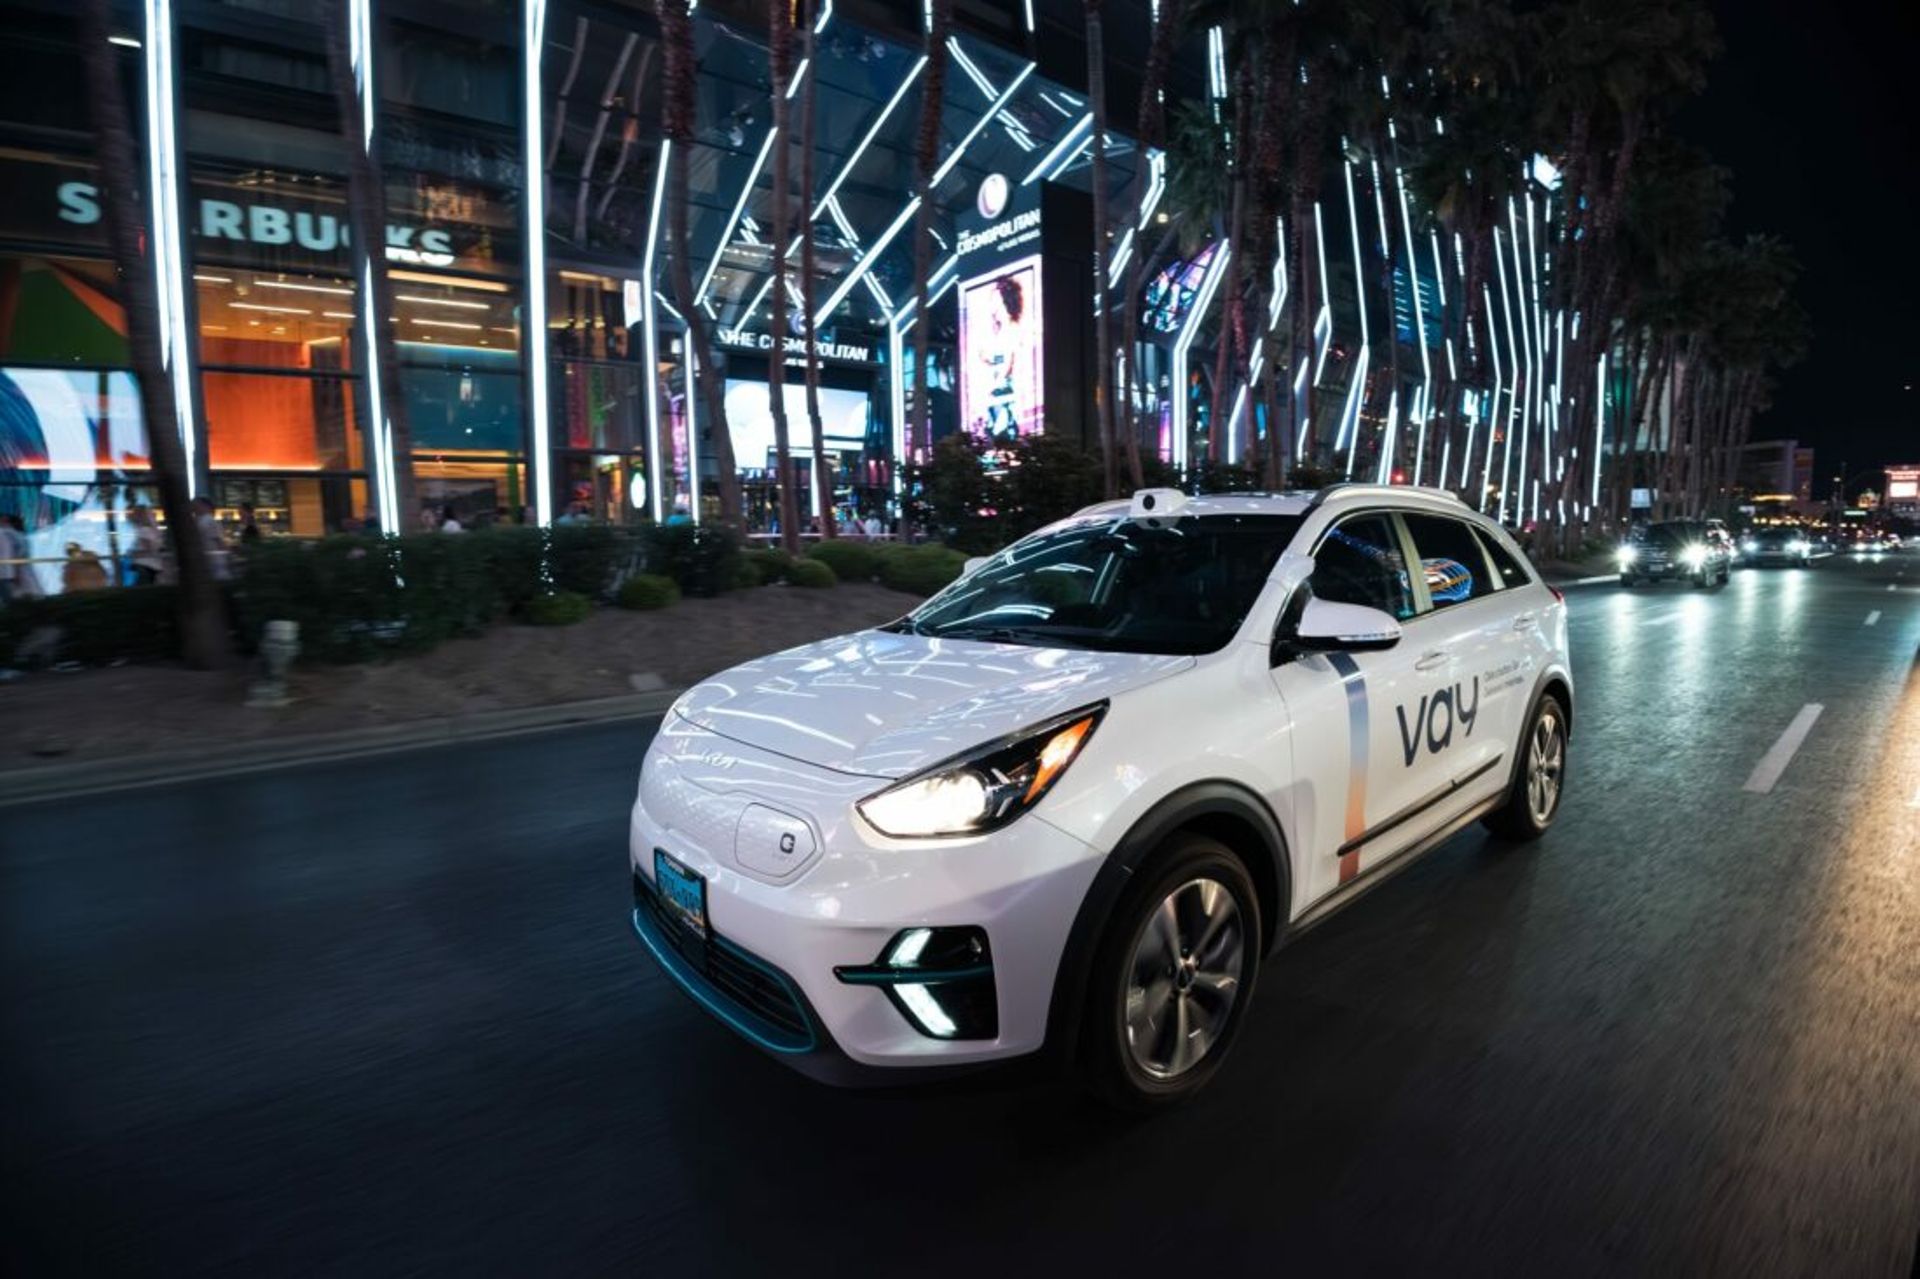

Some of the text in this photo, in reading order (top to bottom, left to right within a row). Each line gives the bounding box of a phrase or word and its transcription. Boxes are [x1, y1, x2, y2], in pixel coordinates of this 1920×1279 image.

[57, 182, 455, 267] SRBUKS
[957, 208, 1041, 255] COSMOPOLITAN
[1396, 675, 1479, 767] vay
